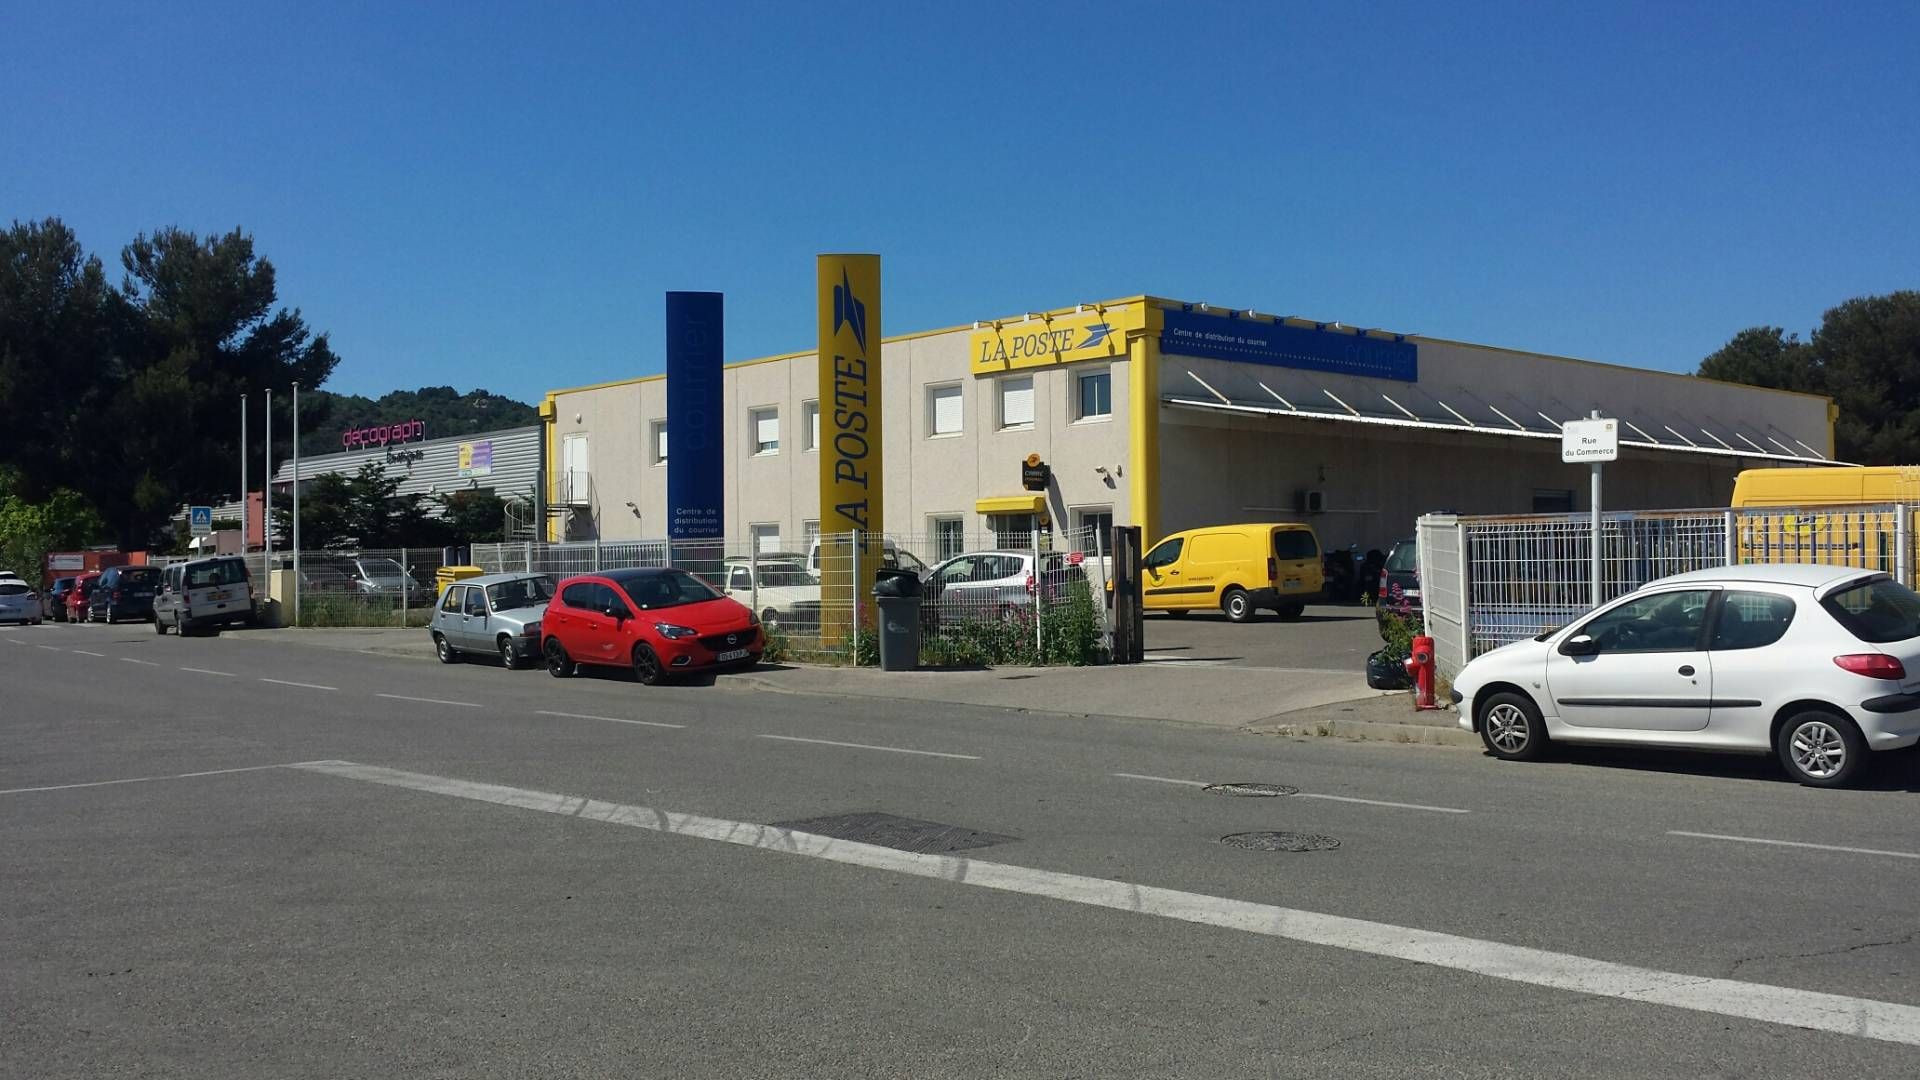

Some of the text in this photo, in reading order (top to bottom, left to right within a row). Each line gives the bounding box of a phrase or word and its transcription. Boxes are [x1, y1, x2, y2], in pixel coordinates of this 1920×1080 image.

[1173, 328, 1193, 338] Centre
[1194, 331, 1203, 339] de
[1204, 333, 1236, 343] distribution
[1237, 336, 1245, 344] du
[979, 328, 1075, 363] LA POSTE
[834, 354, 869, 490] POSTE
[342, 418, 423, 447] décograph
[1581, 437, 1597, 445] Rue
[1565, 448, 1614, 457] du Commerce
[676, 507, 716, 516] Centre de
[674, 517, 718, 525] distribution
[688, 526, 718, 534] courrier
